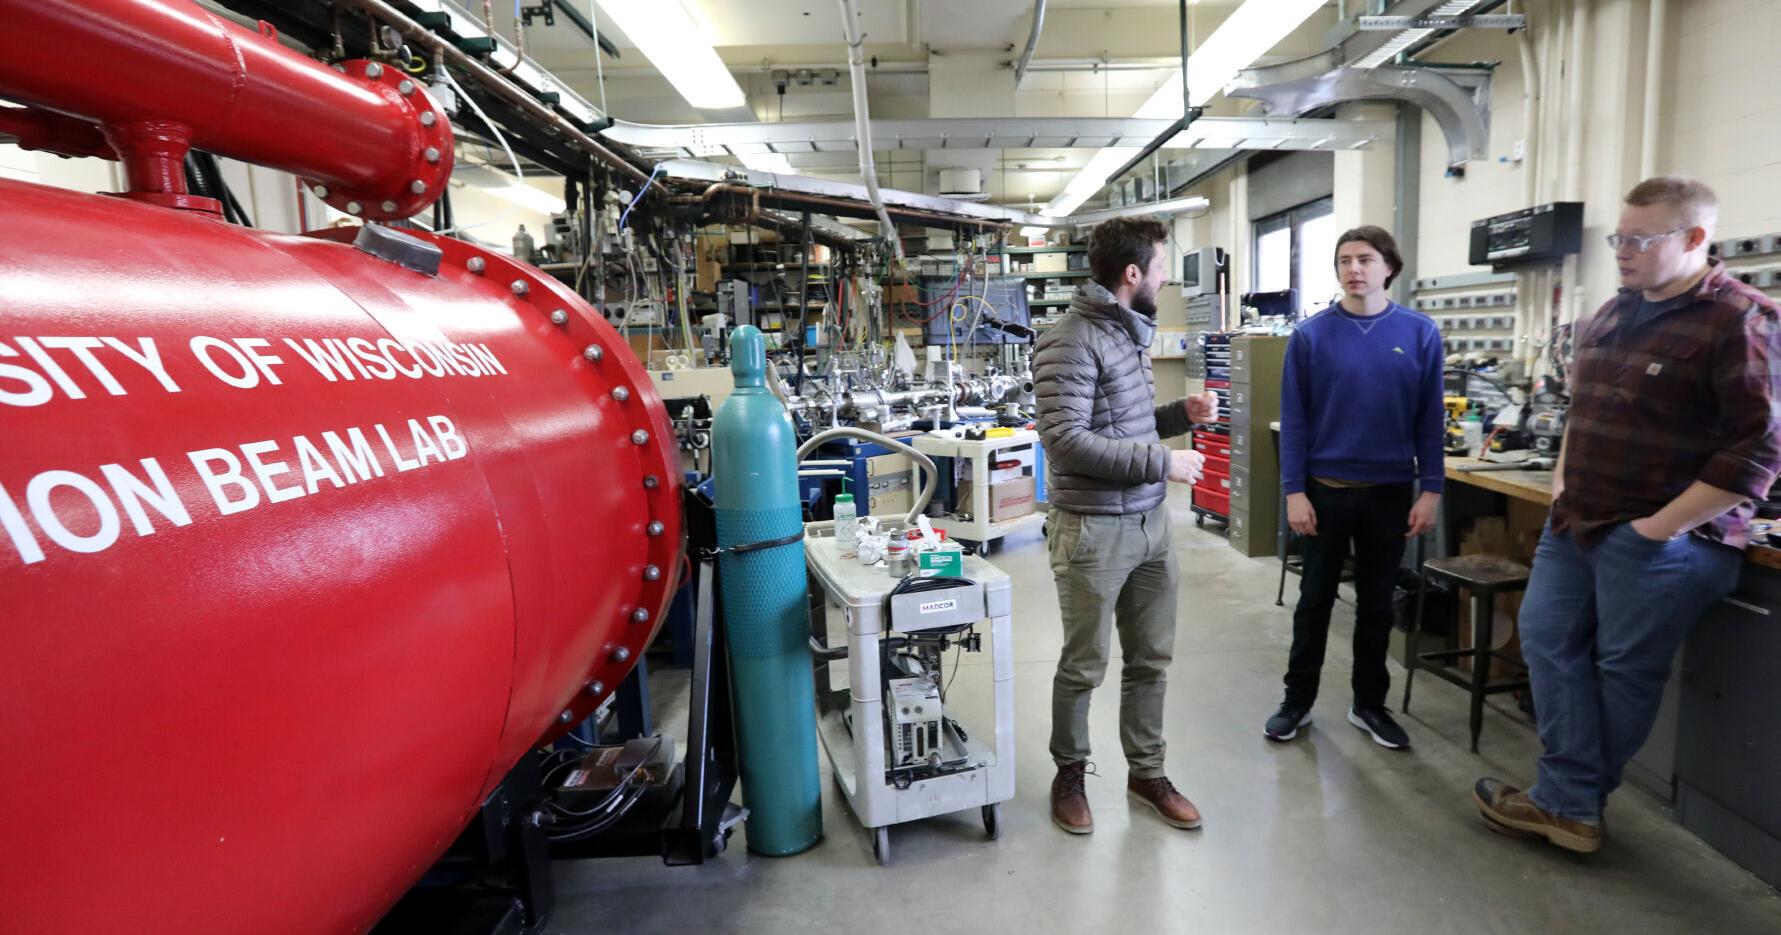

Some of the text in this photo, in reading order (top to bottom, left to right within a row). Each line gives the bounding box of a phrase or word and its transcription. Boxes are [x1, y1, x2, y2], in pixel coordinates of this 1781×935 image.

[0, 335, 507, 407] SITY OF WISCONSIN
[0, 415, 468, 565] ION BEAM LAB
